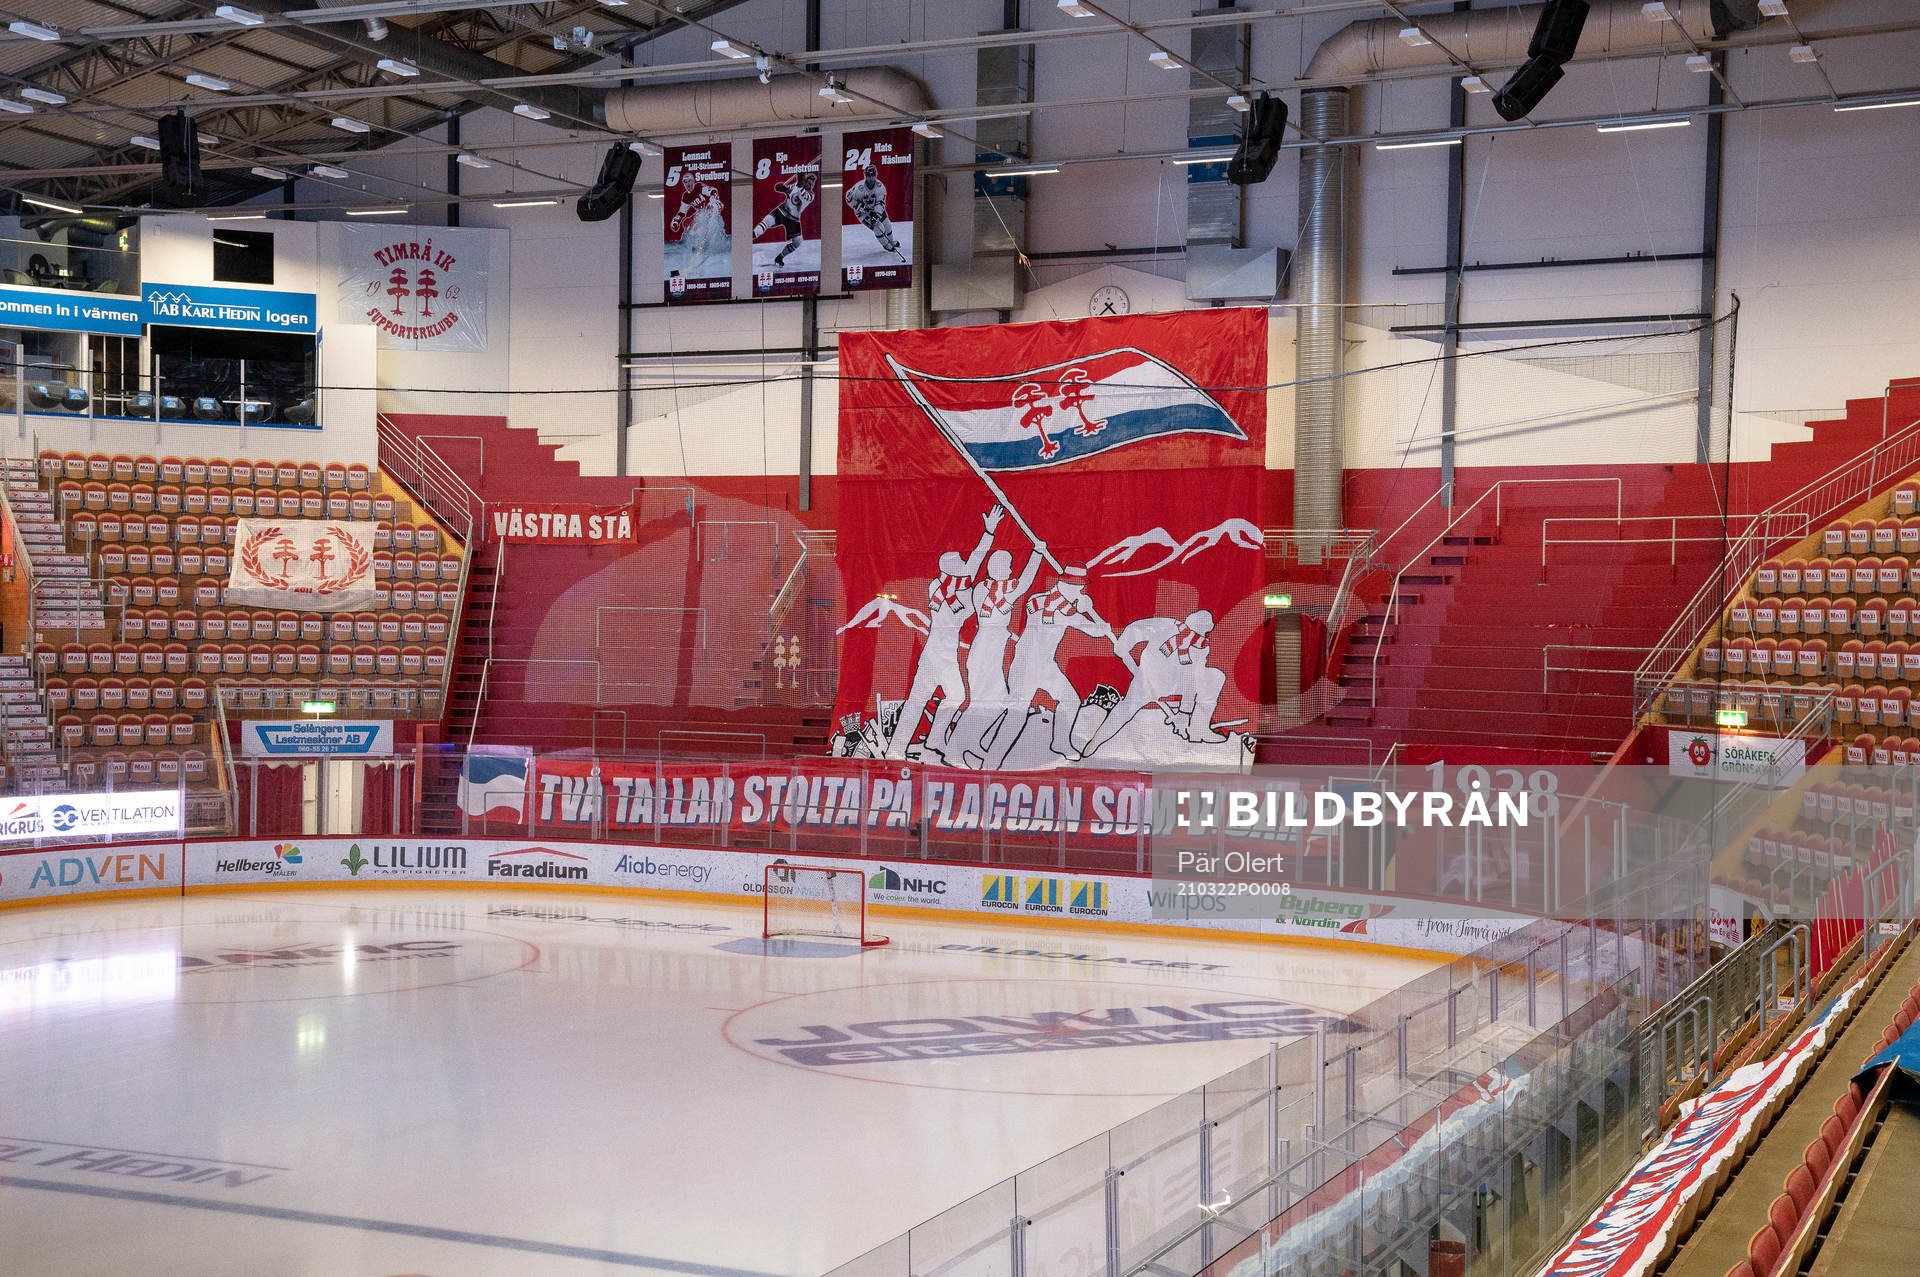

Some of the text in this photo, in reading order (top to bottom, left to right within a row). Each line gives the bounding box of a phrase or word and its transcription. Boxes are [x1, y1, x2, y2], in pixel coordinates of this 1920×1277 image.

[874, 143, 892, 152] Mats
[682, 151, 711, 161] Lennart
[844, 148, 872, 171] 24
[881, 154, 911, 165] Näslund
[755, 158, 771, 179] 8
[665, 166, 682, 187] 5
[695, 171, 729, 182] Svedberg
[373, 238, 456, 272] TIMRÅ IK
[366, 280, 381, 297] 19
[445, 284, 460, 300] 62
[56, 303, 70, 316] in
[74, 306, 79, 318] i
[82, 307, 138, 323] värmen
[182, 305, 216, 319] KARL
[219, 307, 261, 321] HEDIN
[266, 310, 308, 325] logen
[367, 307, 459, 339] SUPPORTERKLUBB
[68, 461, 83, 469] MAXI
[116, 463, 131, 471] MAXI
[212, 466, 227, 474] MAXI
[257, 469, 272, 477] MAXI
[303, 470, 318, 478] MAXI
[350, 471, 364, 479] MAXI
[89, 492, 103, 500] MAXI
[162, 495, 177, 503] MAXI
[213, 496, 228, 504] MAXI
[259, 498, 274, 506] MAXI
[304, 499, 319, 507] MAXI
[354, 501, 369, 509] MAXI
[104, 523, 118, 531] MAXI
[494, 508, 631, 539] VÄSTRA STÅ
[151, 524, 166, 532] MAXI
[419, 531, 434, 539] MAXI
[1851, 532, 1865, 540] MAXI
[184, 556, 199, 564] MAXI
[1882, 571, 1896, 579] MAXI
[137, 587, 151, 595] MAXI
[200, 588, 214, 596] MAXI
[397, 591, 411, 599] MAXI
[442, 591, 457, 599] MAXI
[1757, 610, 1772, 618] MAXI
[1861, 612, 1875, 620] MAXI
[208, 621, 223, 629] MAXI
[256, 622, 271, 630] MAXI
[305, 622, 319, 630] MAXI
[358, 622, 373, 630] MAXI
[405, 623, 419, 631] MAXI
[68, 654, 82, 662] MAXI
[120, 654, 135, 662] MAXI
[170, 655, 184, 663] MAXI
[229, 655, 244, 663] MAXI
[277, 655, 292, 663] MAXI
[380, 656, 395, 664] MAXI
[1752, 652, 1767, 660] MAXI
[1801, 653, 1816, 661] MAXI
[1859, 655, 1873, 663] MAXI
[1905, 657, 1919, 665] MAXI
[51, 690, 65, 698] MAXI
[106, 690, 120, 698] MAXI
[157, 689, 171, 697] MAXI
[66, 726, 81, 734] MAXI
[125, 726, 139, 734] MAXI
[345, 735, 360, 744] AB
[1893, 755, 1906, 763] MAXI
[161, 762, 176, 770] MAXI
[540, 767, 604, 824] TVÅ
[613, 776, 735, 826] TALLAR
[741, 775, 861, 827] STOLTA
[868, 767, 912, 829] PÅ
[926, 781, 1083, 832] FLAGGAN
[80, 806, 175, 823] VENTILATION
[373, 845, 467, 868] LILIUM
[30, 852, 165, 889] ADVEN
[216, 858, 282, 875] Hellbergs
[488, 860, 589, 880] Faradium
[273, 868, 298, 877] MÅLERI
[903, 878, 947, 894] NHC
[873, 893, 885, 901] We
[907, 895, 919, 903] the
[981, 901, 1019, 910] EUROCON
[1025, 903, 1063, 913] EUROCON
[1280, 894, 1364, 919] Byberg
[1069, 907, 1108, 916] EUROCON
[1275, 914, 1341, 929] & Nordin
[1425, 916, 1453, 938] from
[752, 1000, 1316, 1047] JOWIC
[826, 1027, 1208, 1062] elteknik
[34, 1150, 273, 1188] HEDIN
